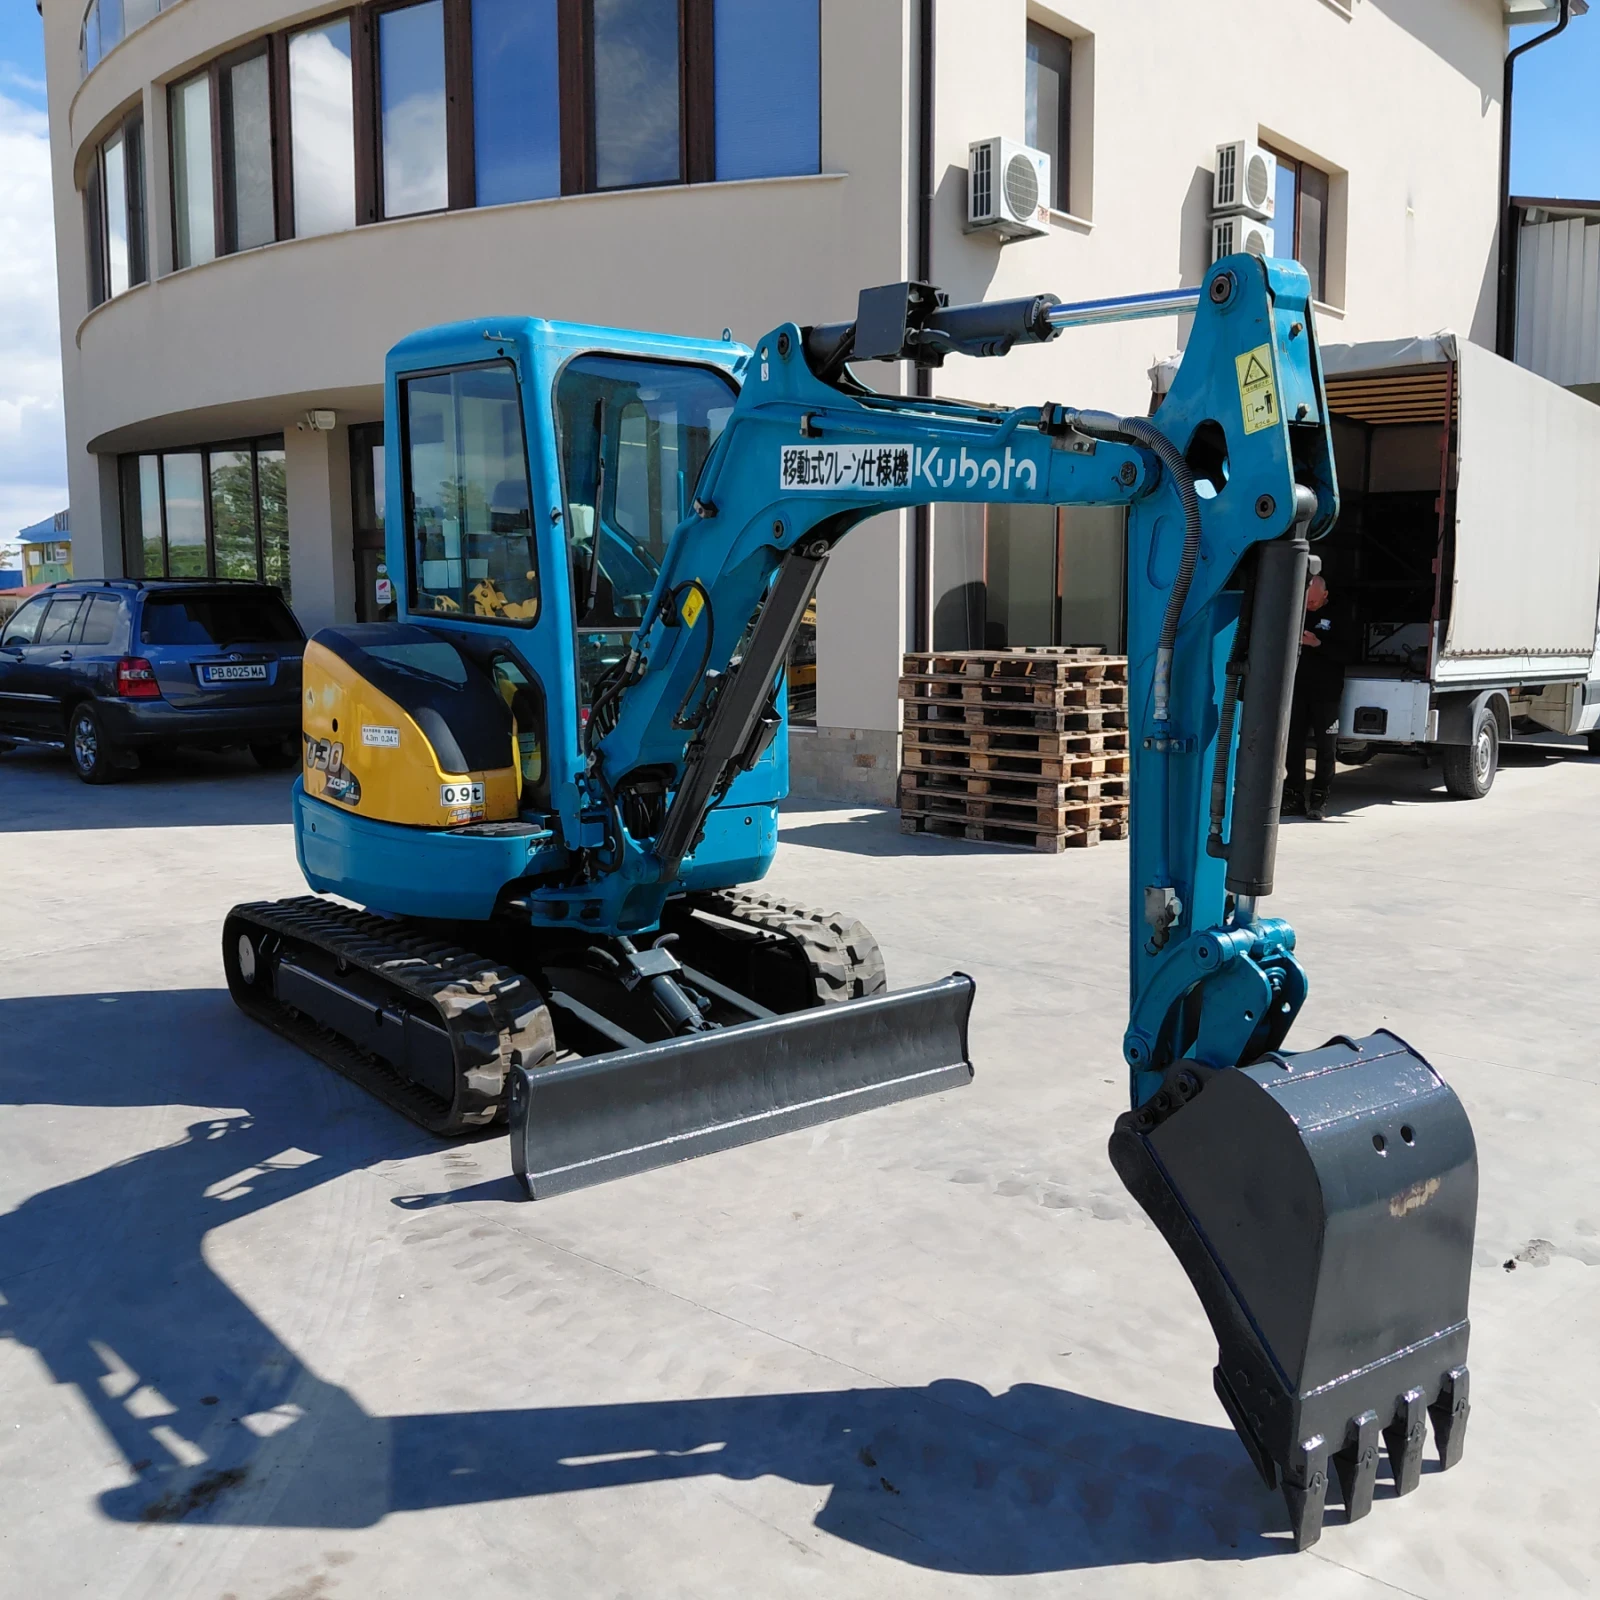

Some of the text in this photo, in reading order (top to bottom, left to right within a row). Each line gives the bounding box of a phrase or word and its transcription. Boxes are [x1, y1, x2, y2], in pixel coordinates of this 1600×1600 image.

[782, 448, 909, 488] 移動式クレーン仕様機
[915, 446, 1038, 490] Kubota
[306, 737, 343, 773] U-30
[444, 787, 481, 802] 0.9t
